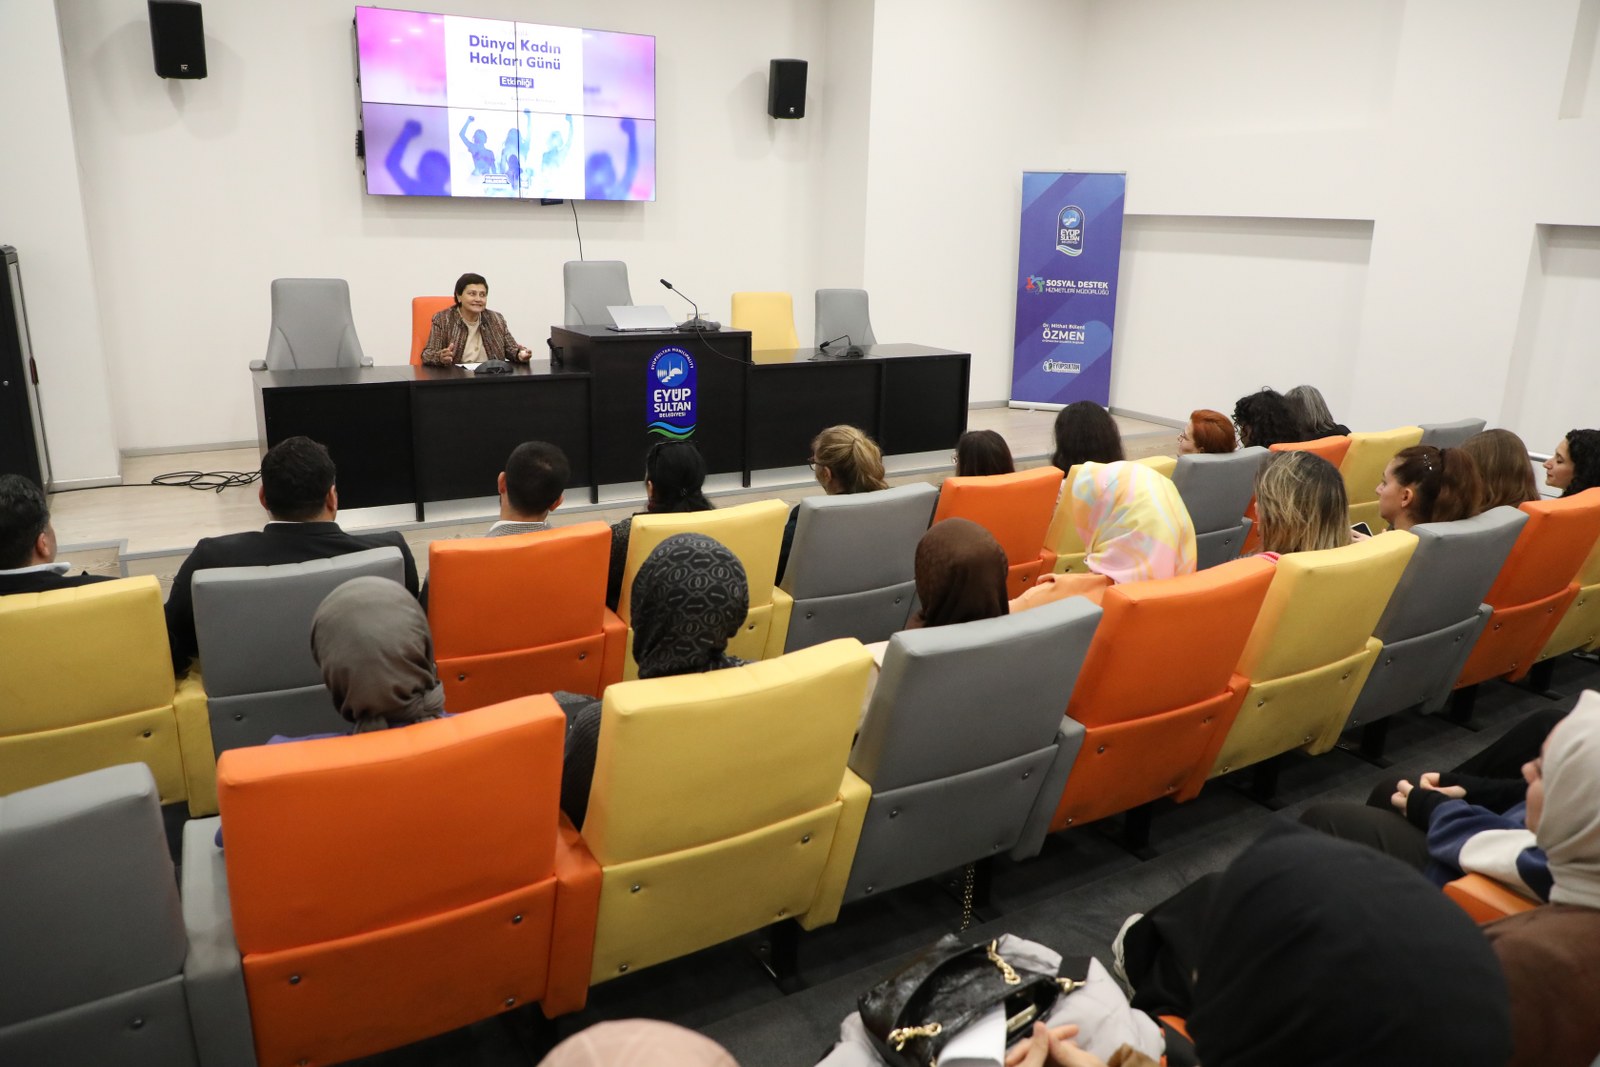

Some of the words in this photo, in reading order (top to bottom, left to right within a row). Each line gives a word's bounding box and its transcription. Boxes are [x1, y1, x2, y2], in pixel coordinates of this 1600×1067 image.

[469, 34, 515, 52] Dünya
[520, 39, 561, 54] Kadın
[469, 52, 522, 67] Hakları
[526, 56, 561, 70] Günü
[1046, 279, 1076, 287] SOSYAL
[1078, 281, 1109, 289] DESTEK
[1042, 328, 1085, 341] ÖZMEN
[653, 388, 692, 402] EYÜP
[653, 401, 692, 413] SULTAN
